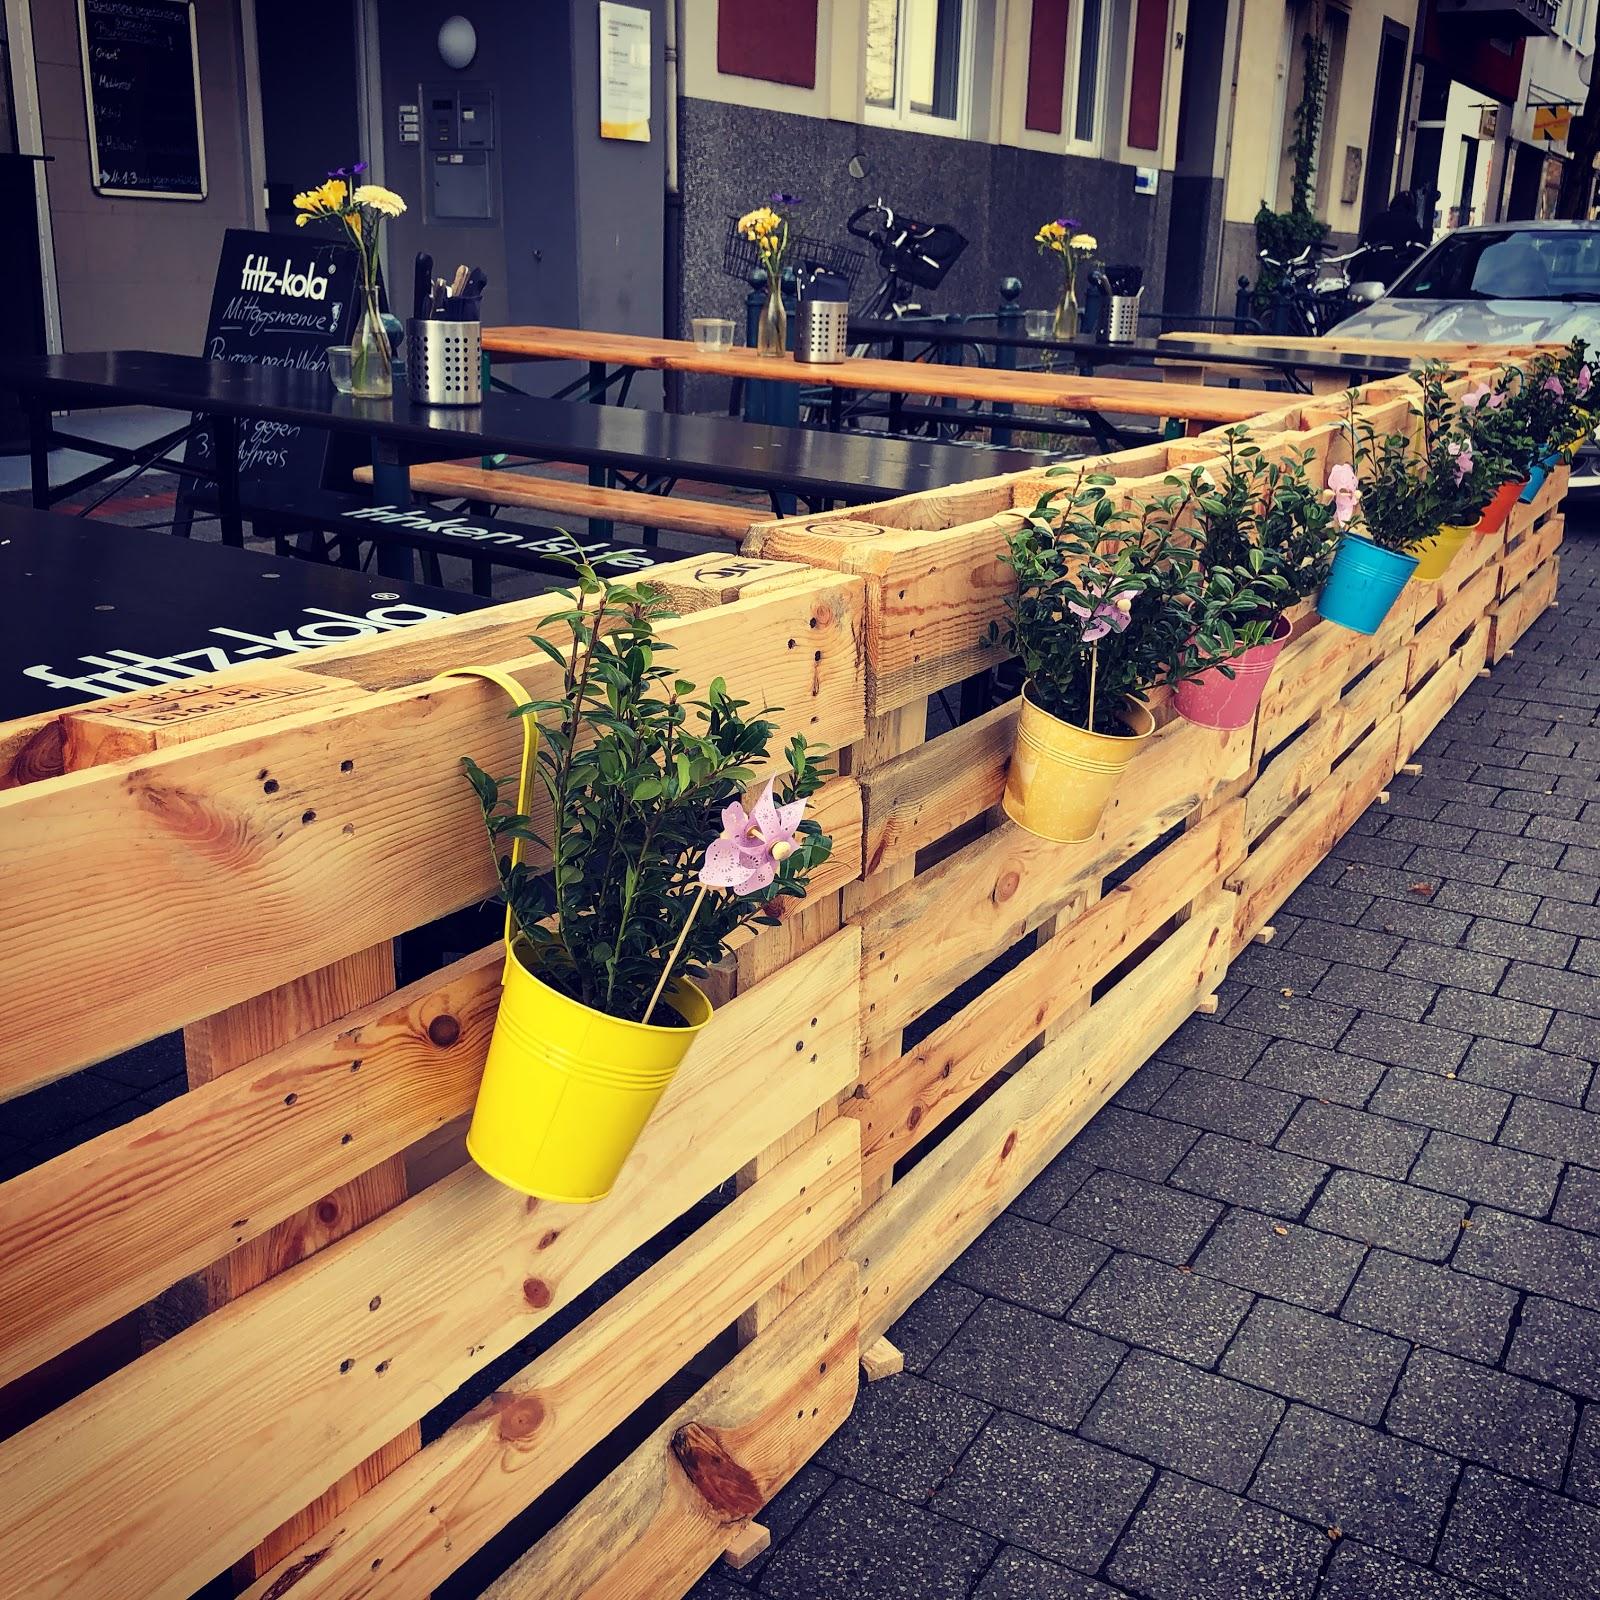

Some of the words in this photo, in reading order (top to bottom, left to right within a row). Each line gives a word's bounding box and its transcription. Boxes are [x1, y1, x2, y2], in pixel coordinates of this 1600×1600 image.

[295, 344, 331, 373] Wah
[250, 419, 301, 444] gegen
[340, 505, 524, 545] trinken
[515, 535, 612, 556] ist
[586, 548, 656, 569] fe
